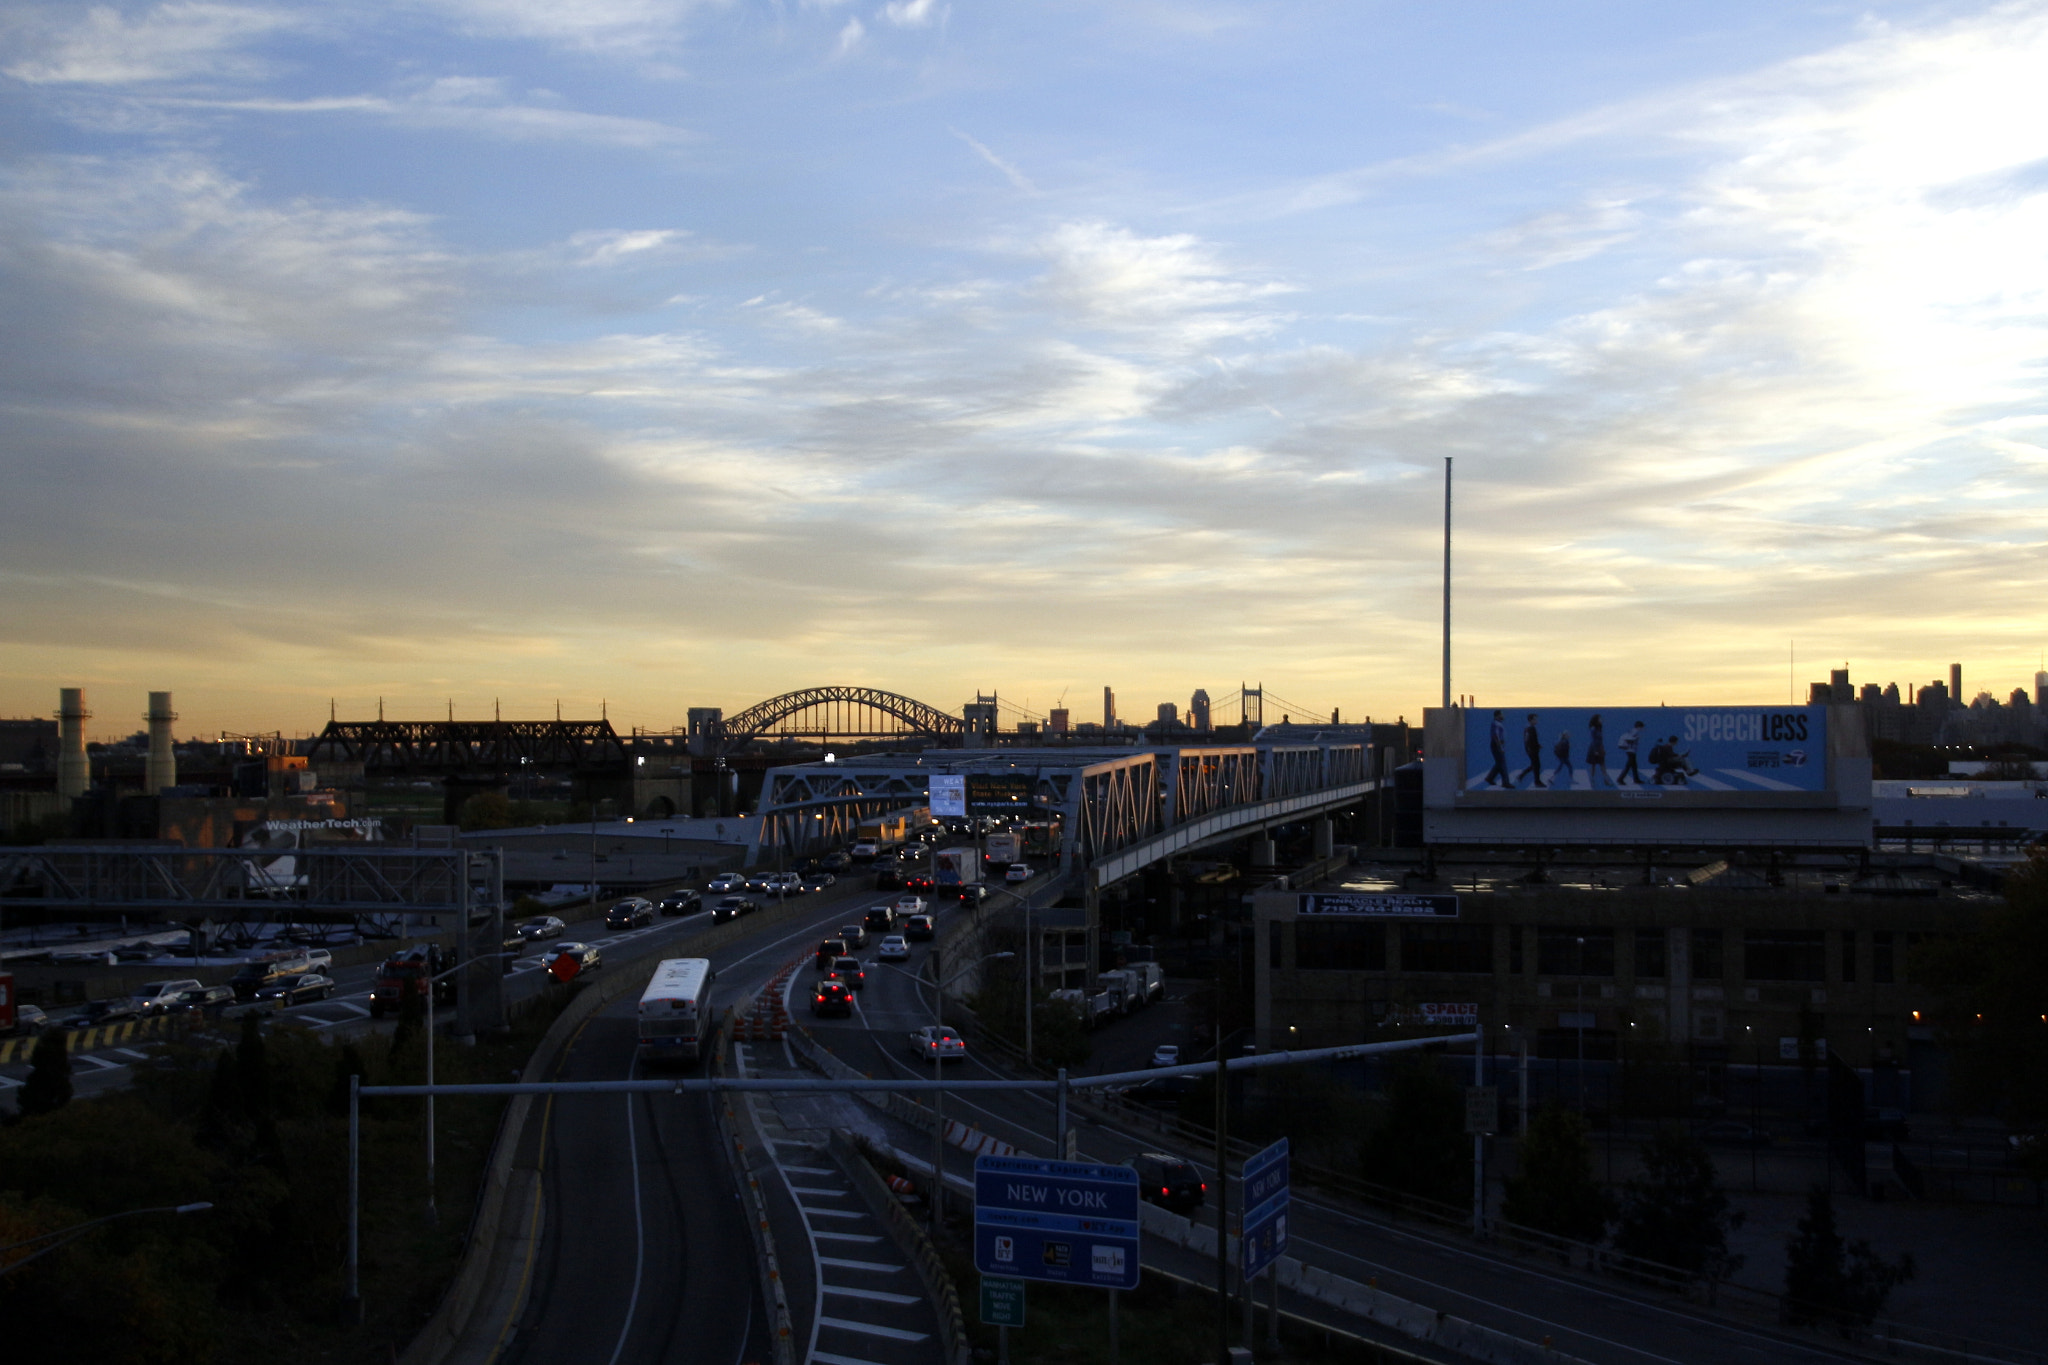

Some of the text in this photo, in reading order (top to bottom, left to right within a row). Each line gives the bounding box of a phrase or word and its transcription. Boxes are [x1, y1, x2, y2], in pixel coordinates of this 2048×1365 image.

[266, 819, 382, 831] WeatherTech.com
[1323, 897, 1383, 905] PINNACLE
[1425, 1004, 1478, 1015] SPACE
[983, 1158, 1131, 1180] Experience Explore Enjoy
[1252, 1167, 1281, 1200] NEW YORK
[1007, 1183, 1108, 1209] NEW YORK
[983, 1280, 1023, 1291] MANHATTAN
[989, 1290, 1017, 1301] TRAFFIC
